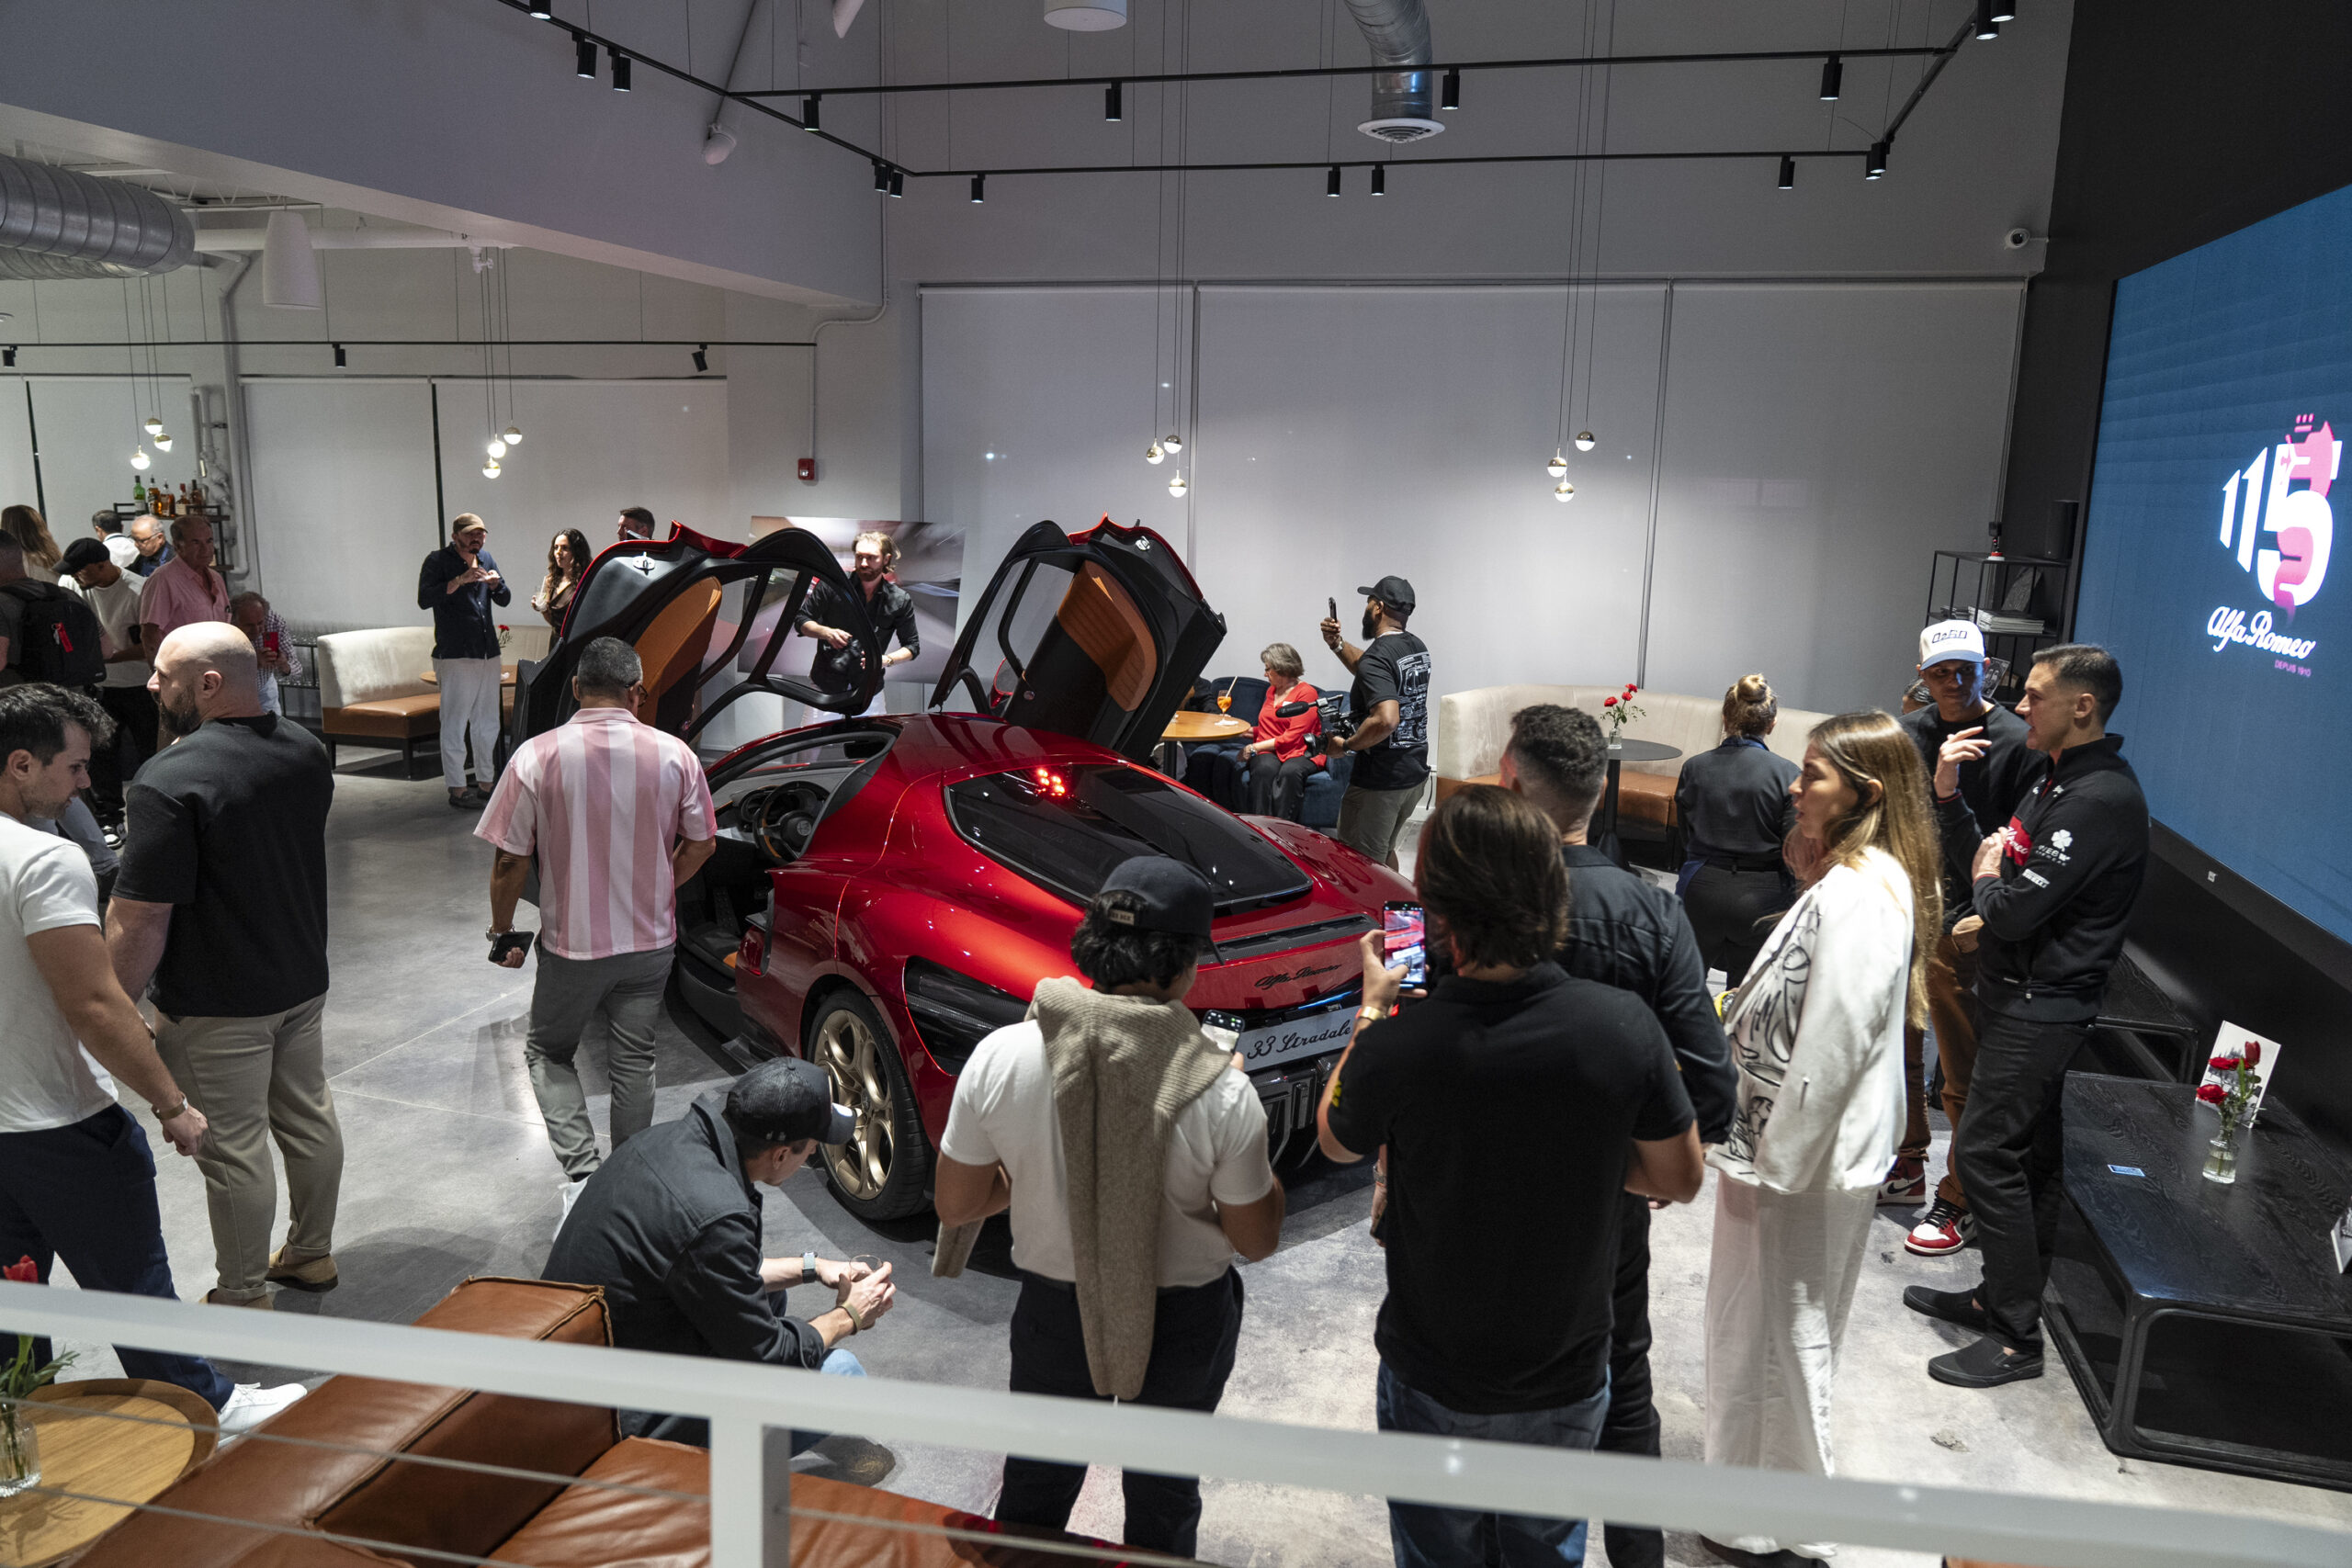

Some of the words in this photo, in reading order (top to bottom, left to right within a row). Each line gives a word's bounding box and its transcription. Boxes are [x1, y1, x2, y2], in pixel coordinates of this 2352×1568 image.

[2207, 606, 2248, 652] Alfa
[2245, 610, 2316, 660] Romeo
[1255, 973, 1292, 990] Alfa
[1293, 966, 1342, 980] Romeo
[1247, 1035, 1277, 1060] 33
[1275, 1019, 1351, 1053] Stradale
